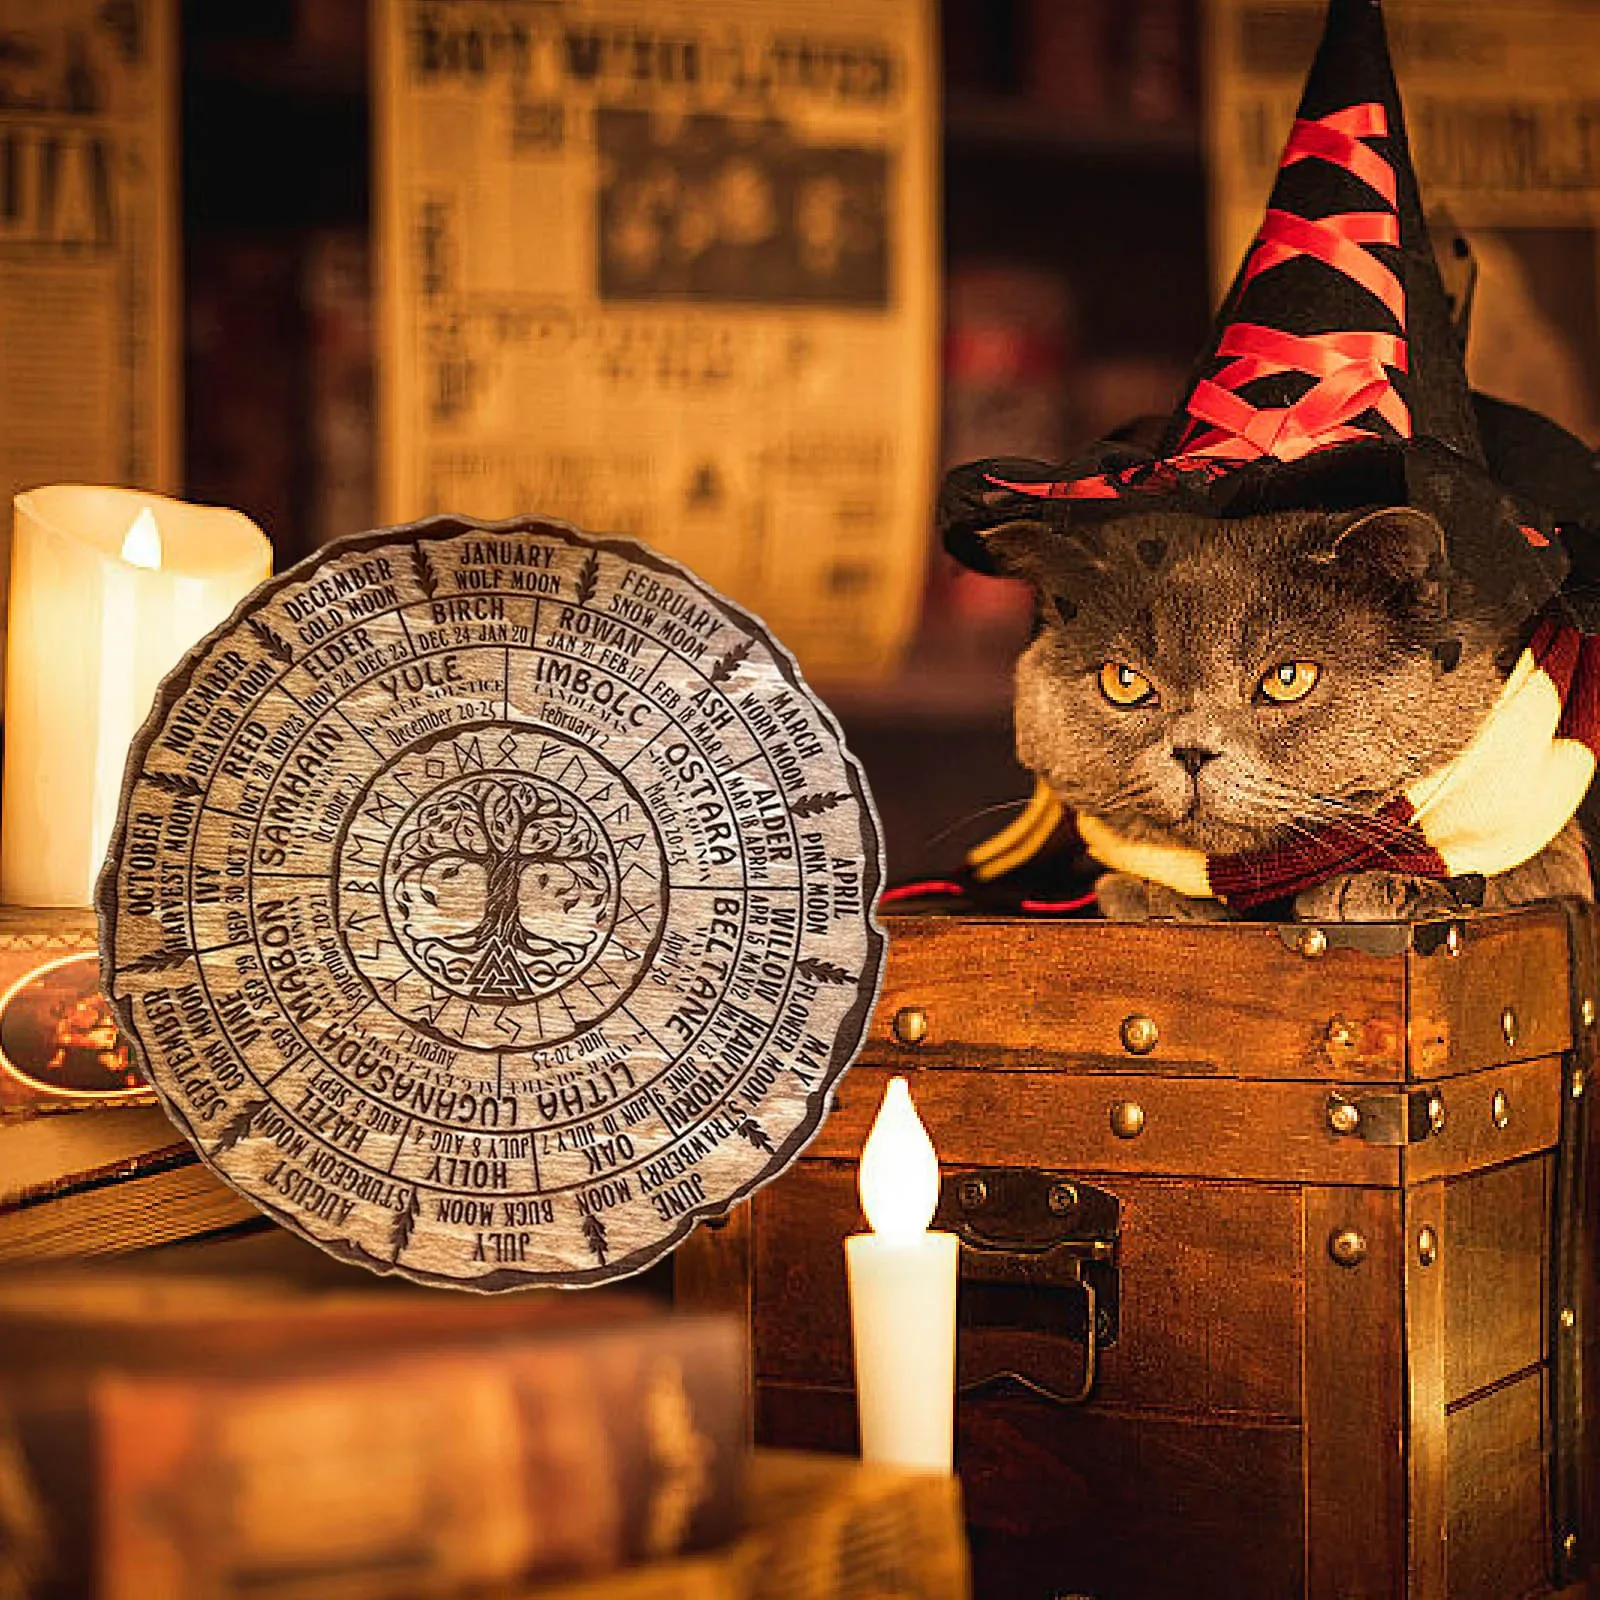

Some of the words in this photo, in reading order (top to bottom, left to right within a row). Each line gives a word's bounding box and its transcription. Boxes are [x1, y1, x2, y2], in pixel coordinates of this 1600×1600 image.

[459, 541, 554, 568] JANUARY
[282, 556, 393, 624] DECEMBER
[453, 568, 503, 590] WOLF
[510, 569, 561, 594] MOON
[620, 568, 723, 638] FEBRUARY
[297, 603, 343, 645] COLD
[344, 584, 398, 619] MOON
[431, 595, 504, 625] BIRCH
[559, 606, 644, 656] ROWAN
[607, 592, 658, 628] SNOW
[656, 619, 708, 660] MOON
[301, 621, 373, 681] ELDER
[417, 627, 451, 656] DEC
[452, 625, 471, 648] 24
[477, 623, 507, 642] JAN
[510, 620, 528, 643] 20
[545, 630, 578, 653] JAN
[598, 647, 629, 674] FEB
[303, 680, 335, 713] NOV
[332, 667, 356, 689] 24
[353, 648, 388, 676] DEC
[378, 654, 463, 701] YULE
[535, 656, 651, 726] IMBOLC
[162, 650, 247, 755] NOVEMBER
[185, 707, 238, 776] BEAVER
[227, 658, 276, 708] MOON
[539, 700, 600, 743] February
[649, 680, 681, 709] FEB
[676, 705, 696, 724] 18
[690, 721, 722, 755] MAR
[689, 687, 734, 730] ASH
[767, 691, 823, 759] MARCH
[221, 721, 268, 779] REED
[386, 707, 454, 752] December
[739, 692, 780, 740] WORN
[768, 741, 807, 792] MOON
[251, 759, 275, 780] 28
[237, 780, 266, 814] OCT
[258, 723, 343, 866] SAMHAIN
[309, 789, 350, 843] October
[637, 780, 678, 828] March
[664, 742, 736, 865] OSTARA
[724, 776, 752, 811] MAR
[738, 813, 760, 829] 18
[163, 799, 195, 853] MOON
[229, 822, 251, 840] 27
[752, 789, 792, 861] ALDER
[126, 812, 163, 916] OCTOBER
[224, 844, 247, 877] OCT
[800, 832, 827, 874] PINK
[159, 860, 187, 949] HARVEST
[194, 864, 221, 904] IVY
[831, 857, 859, 919] APRIL
[226, 910, 250, 944] SEP
[748, 894, 769, 925] APR
[805, 882, 829, 935] MOON
[657, 929, 690, 969] April
[745, 930, 766, 945] 15
[754, 907, 795, 1004] WILLOW
[234, 954, 258, 975] 29
[257, 899, 321, 1024] MABON
[316, 932, 367, 1011] September
[665, 897, 740, 1041] BELTANE
[174, 982, 215, 1039] MOON
[243, 978, 272, 1010] SEP
[772, 980, 817, 1053] FLOWER
[215, 989, 261, 1049] VINE
[270, 1027, 302, 1058] SEP
[573, 1026, 610, 1056] June
[708, 1005, 740, 1043] MAY
[142, 987, 227, 1120] SEPTEMBER
[200, 1039, 244, 1091] CORN
[404, 1034, 458, 1071] August
[665, 1017, 764, 1127] HAWTHORN
[696, 1038, 717, 1060] 13
[786, 1033, 829, 1086] MAY
[307, 1068, 352, 1107] SEPT
[536, 1061, 635, 1121] LITHA
[650, 1086, 666, 1106] 9
[662, 1055, 700, 1095] JUNE
[738, 1051, 784, 1106] MOON
[293, 1087, 368, 1152] HAZEL
[350, 1098, 366, 1117] 5
[364, 1105, 402, 1135] AUG
[601, 1112, 620, 1136] 10
[619, 1095, 650, 1127] JUN
[253, 1107, 309, 1159] MOON
[412, 1125, 426, 1145] 4
[429, 1129, 464, 1155] AUG
[470, 1136, 481, 1158] 8
[487, 1136, 529, 1159] JULY
[555, 1121, 597, 1152] JULY
[581, 1133, 634, 1175] OAK
[636, 1100, 747, 1193] STRAWBERRY
[262, 1160, 355, 1226] AUGUST
[305, 1148, 409, 1216] STURGEON
[424, 1155, 507, 1189] HOLLY
[436, 1198, 494, 1226] MOON
[503, 1198, 554, 1227] BUCK
[575, 1177, 632, 1216] MOON
[650, 1172, 705, 1222] JUNE
[472, 1231, 530, 1262] JULY
